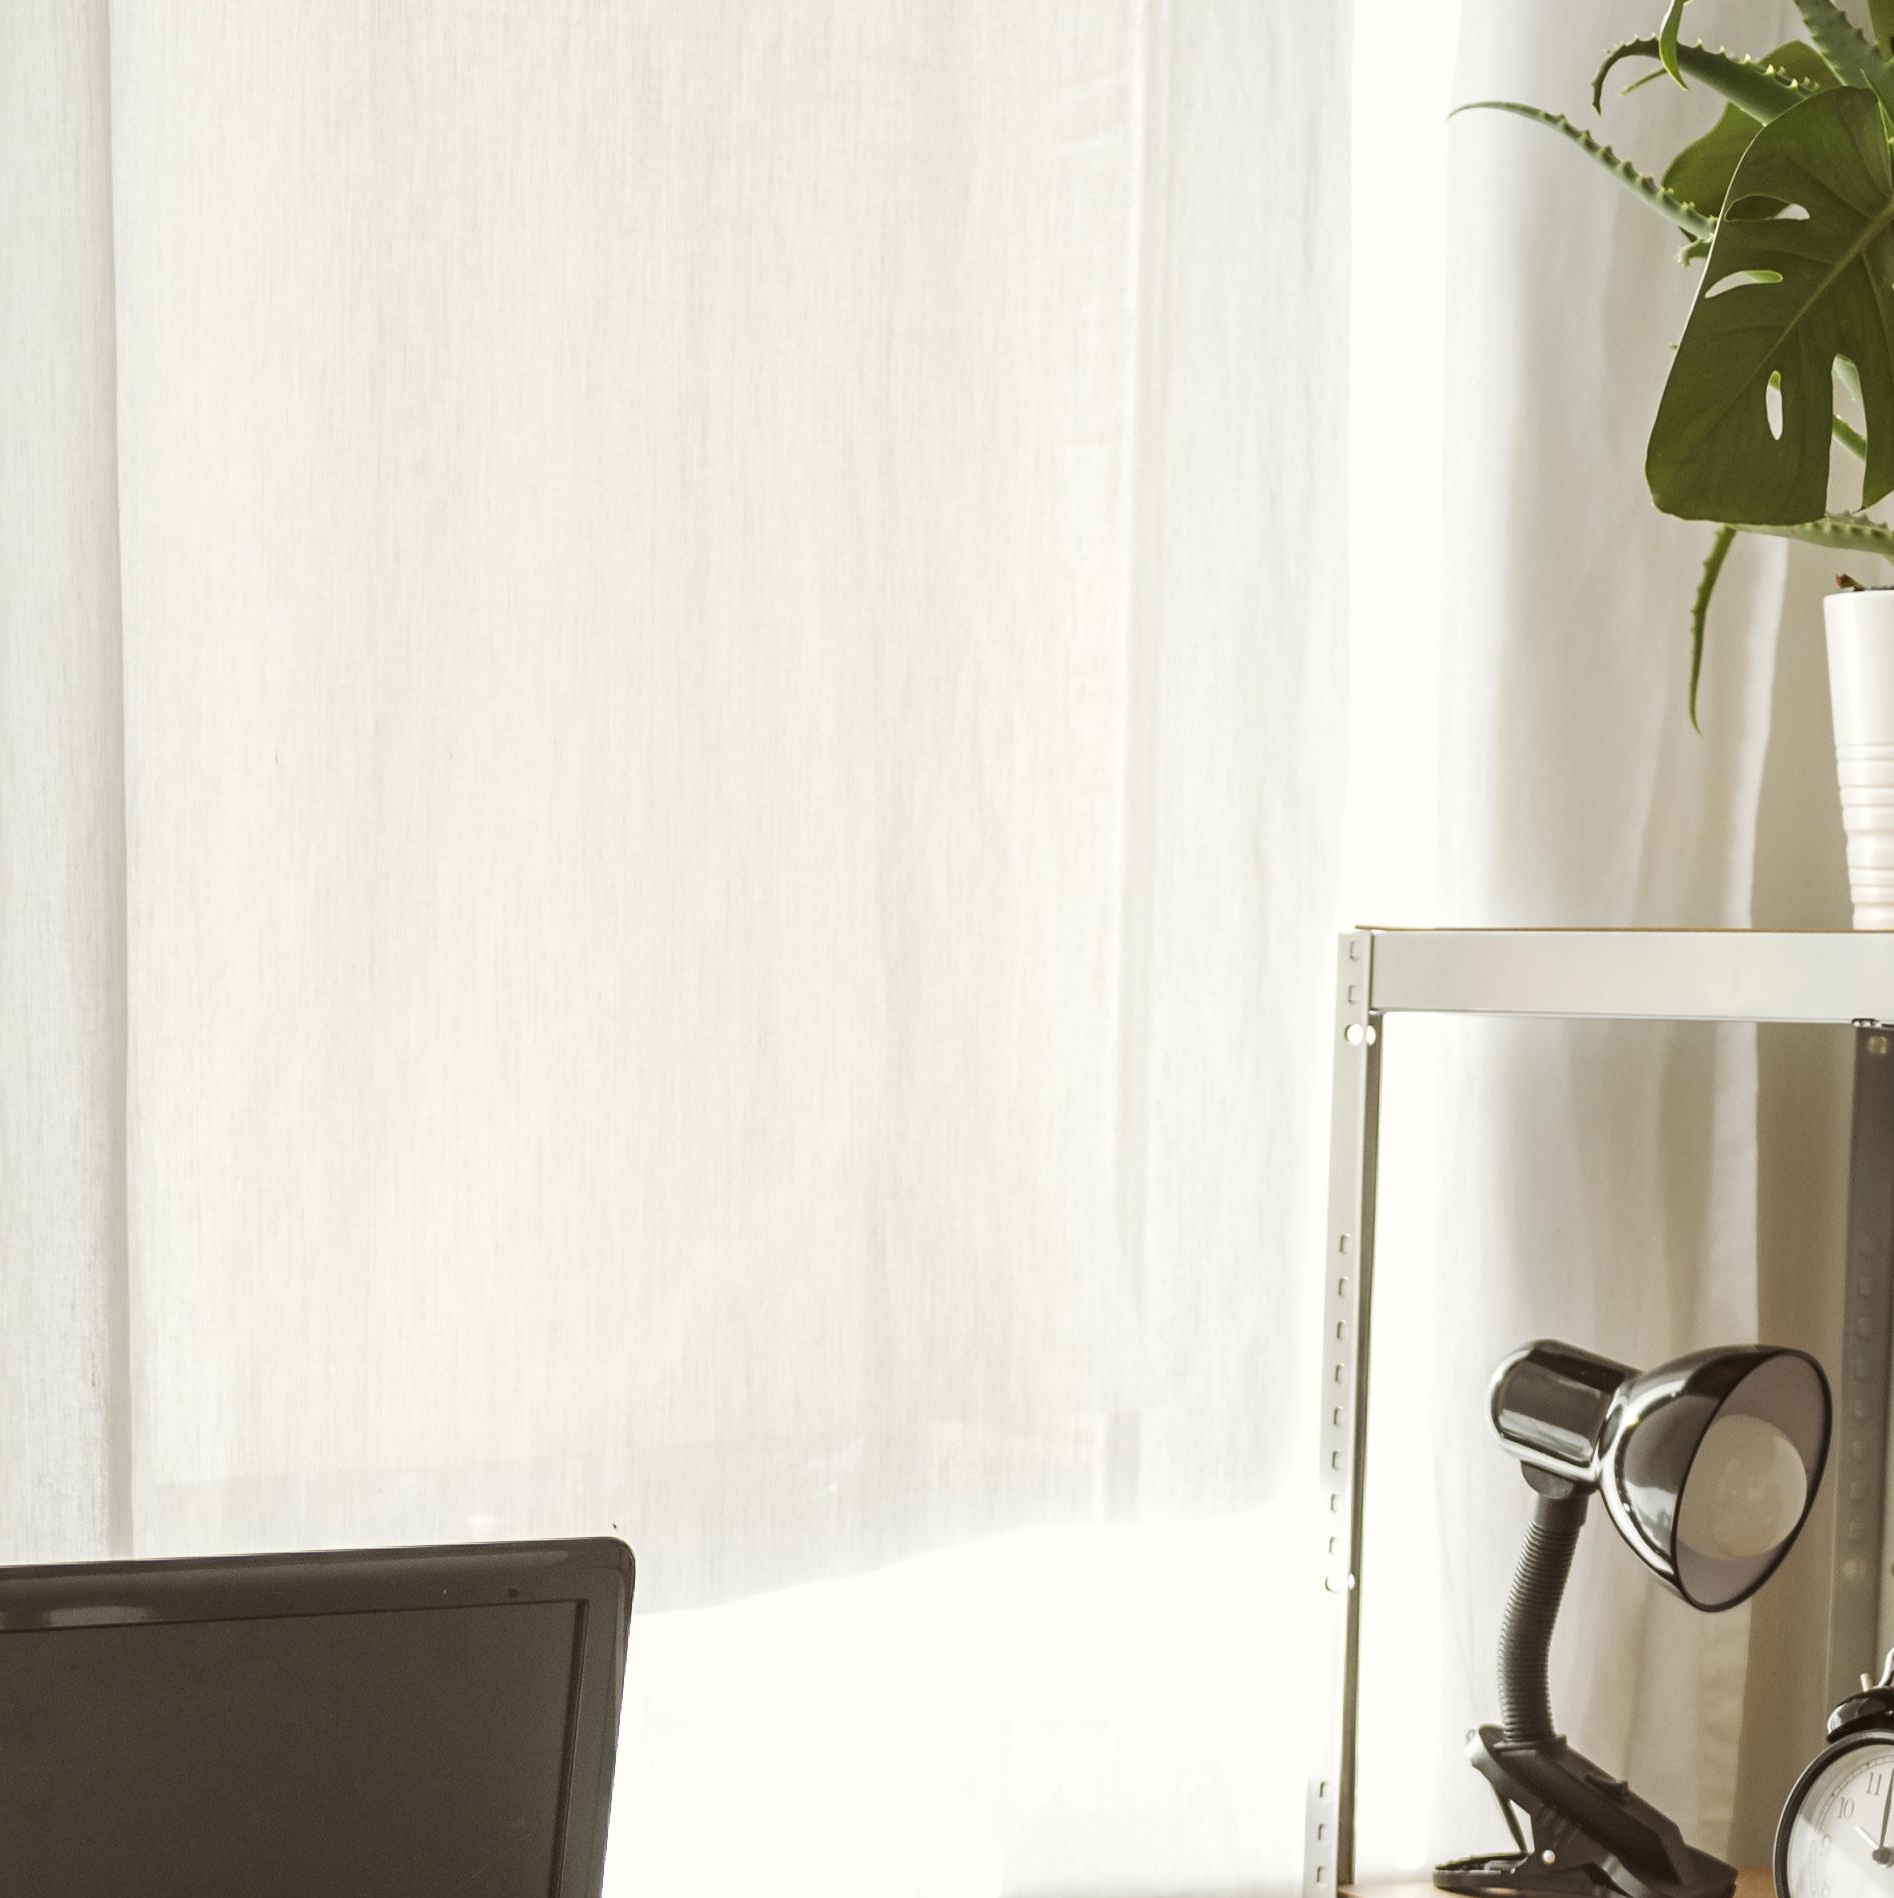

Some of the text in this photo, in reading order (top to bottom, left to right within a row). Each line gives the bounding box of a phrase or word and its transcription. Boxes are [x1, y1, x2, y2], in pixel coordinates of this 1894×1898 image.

[1865, 1772, 1883, 1796] 11
[1837, 1797, 1855, 1821] 10
[1820, 1834, 1833, 1857] 9
[1820, 1876, 1833, 1898] 8
